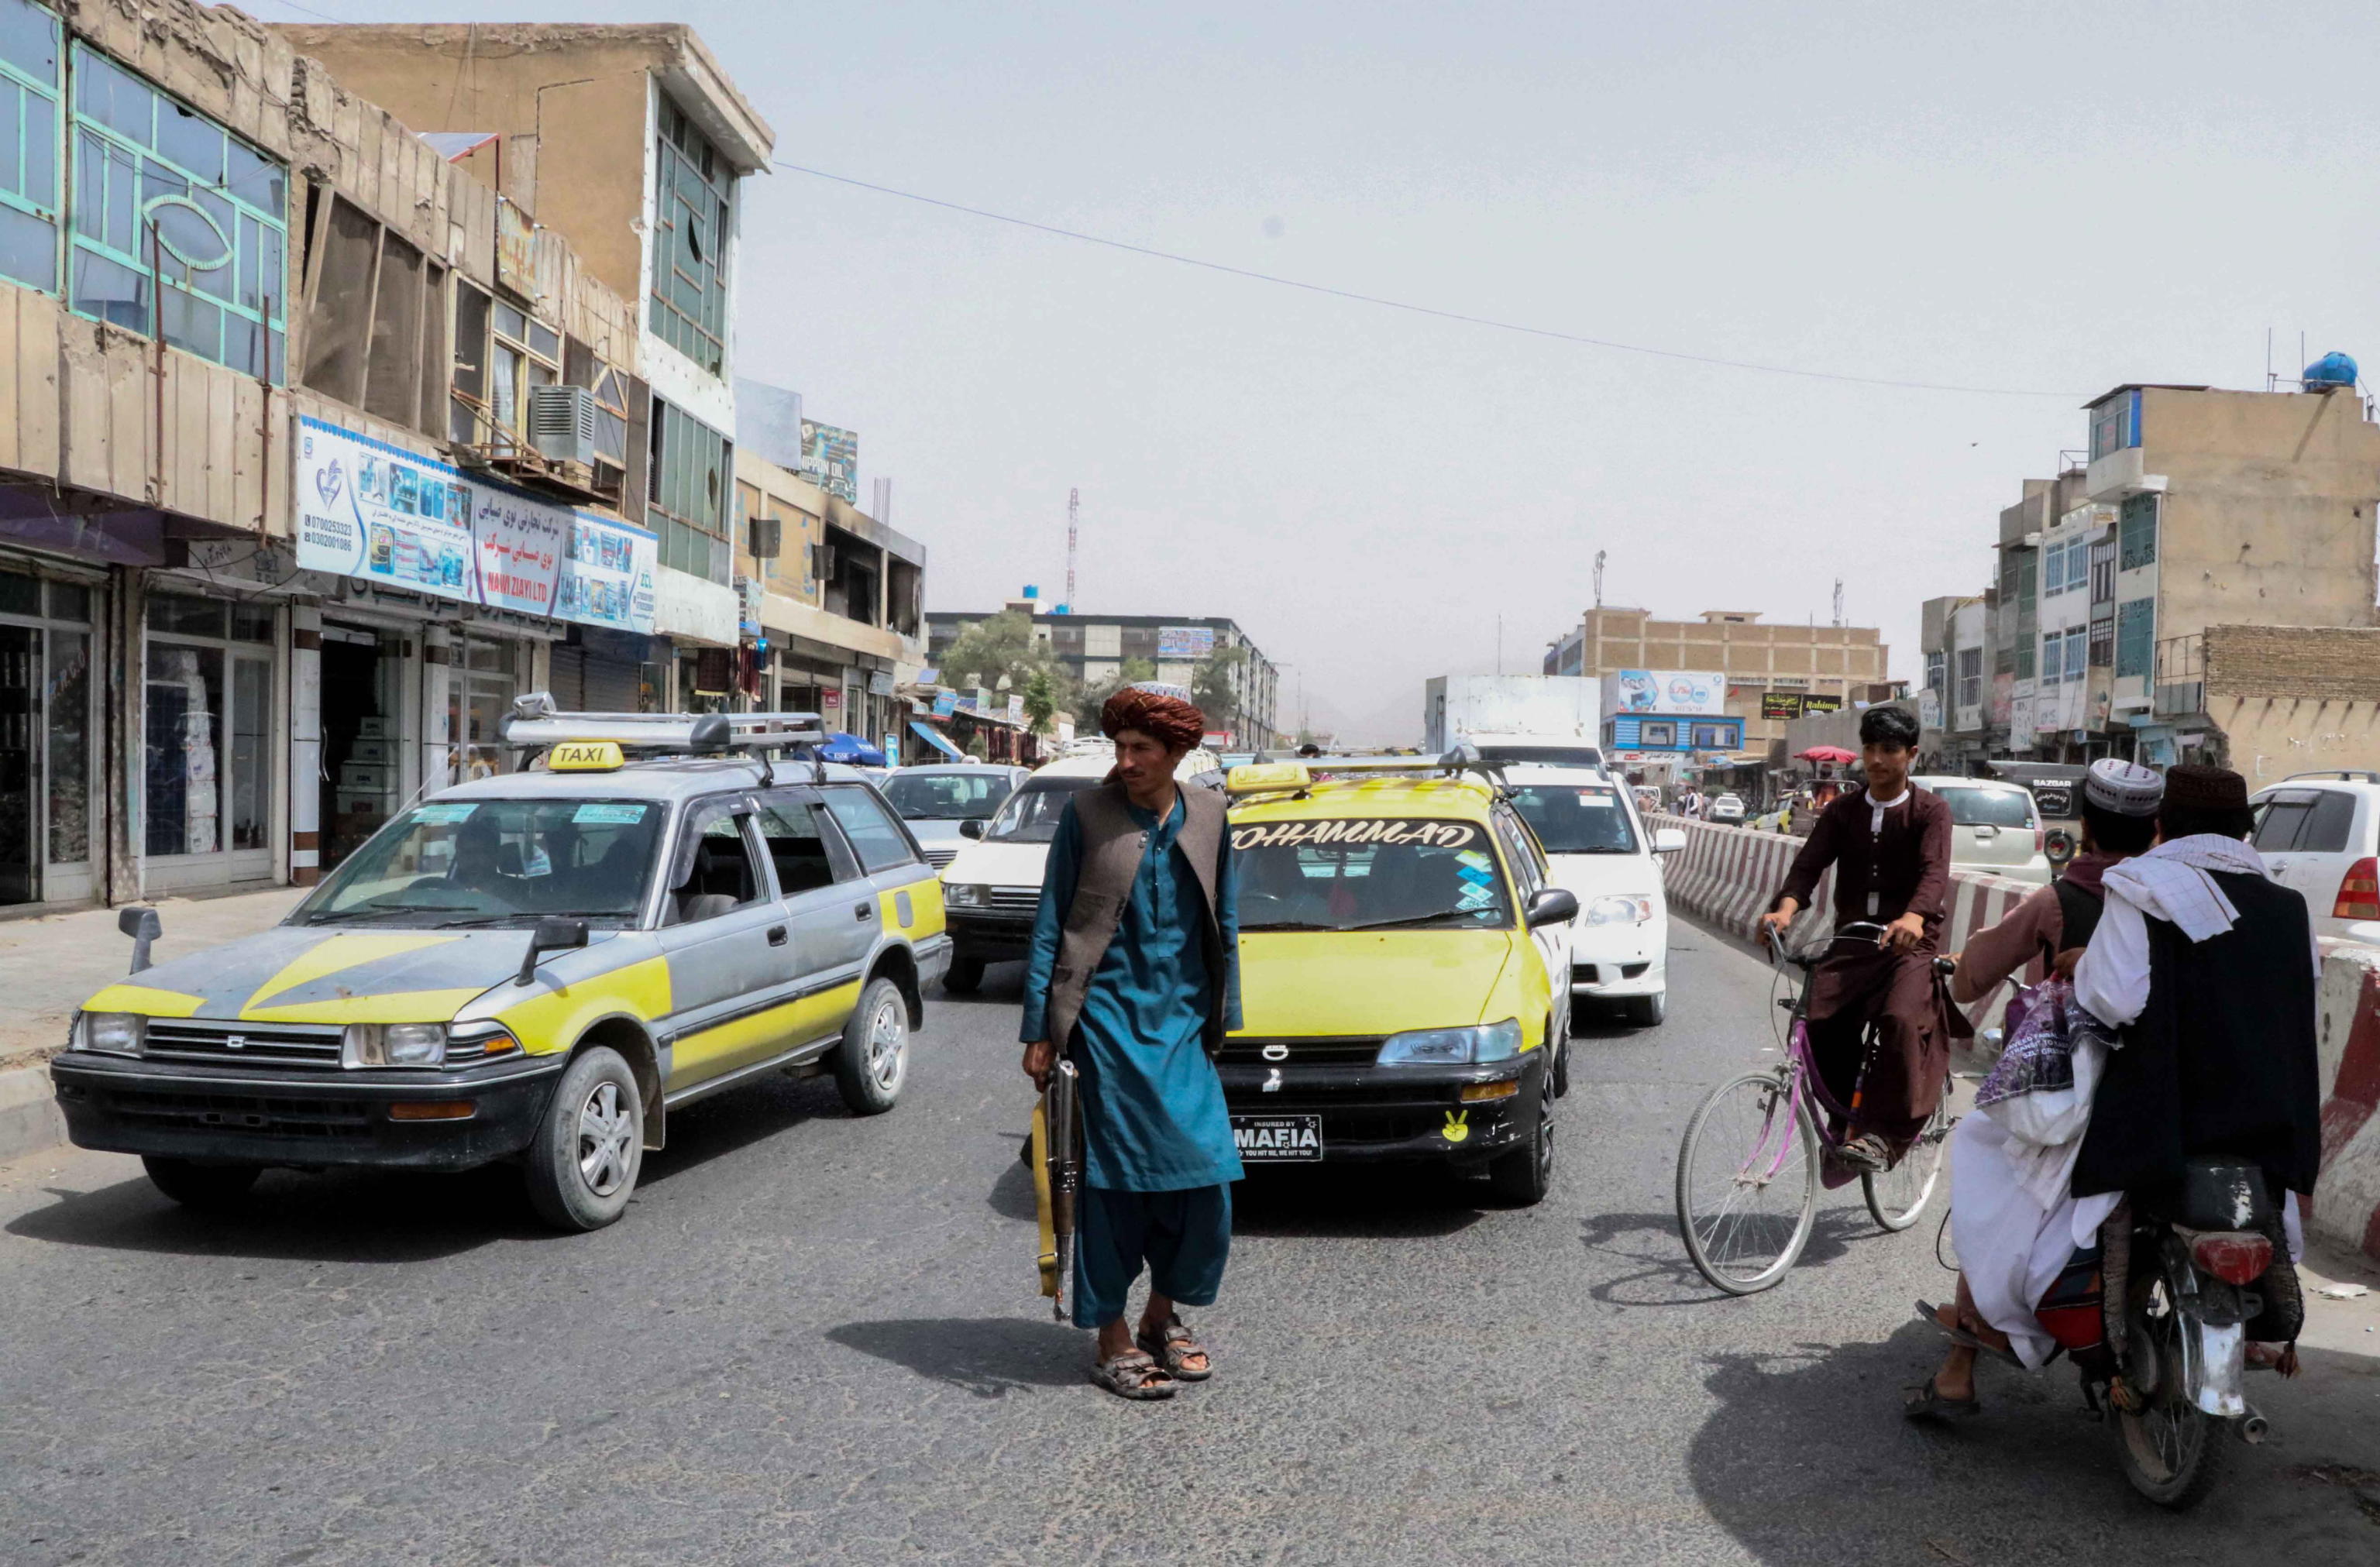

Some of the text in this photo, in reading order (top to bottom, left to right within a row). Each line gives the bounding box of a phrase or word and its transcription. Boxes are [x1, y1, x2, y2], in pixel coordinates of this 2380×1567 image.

[831, 462, 845, 478] OIL
[488, 572, 510, 596] NAWI
[533, 582, 547, 603] LTD
[560, 747, 604, 762] TAXI
[2033, 779, 2072, 788] SAZGAR
[1232, 820, 1475, 850] OHAMMAD
[1233, 1129, 1319, 1148] MAFIA
